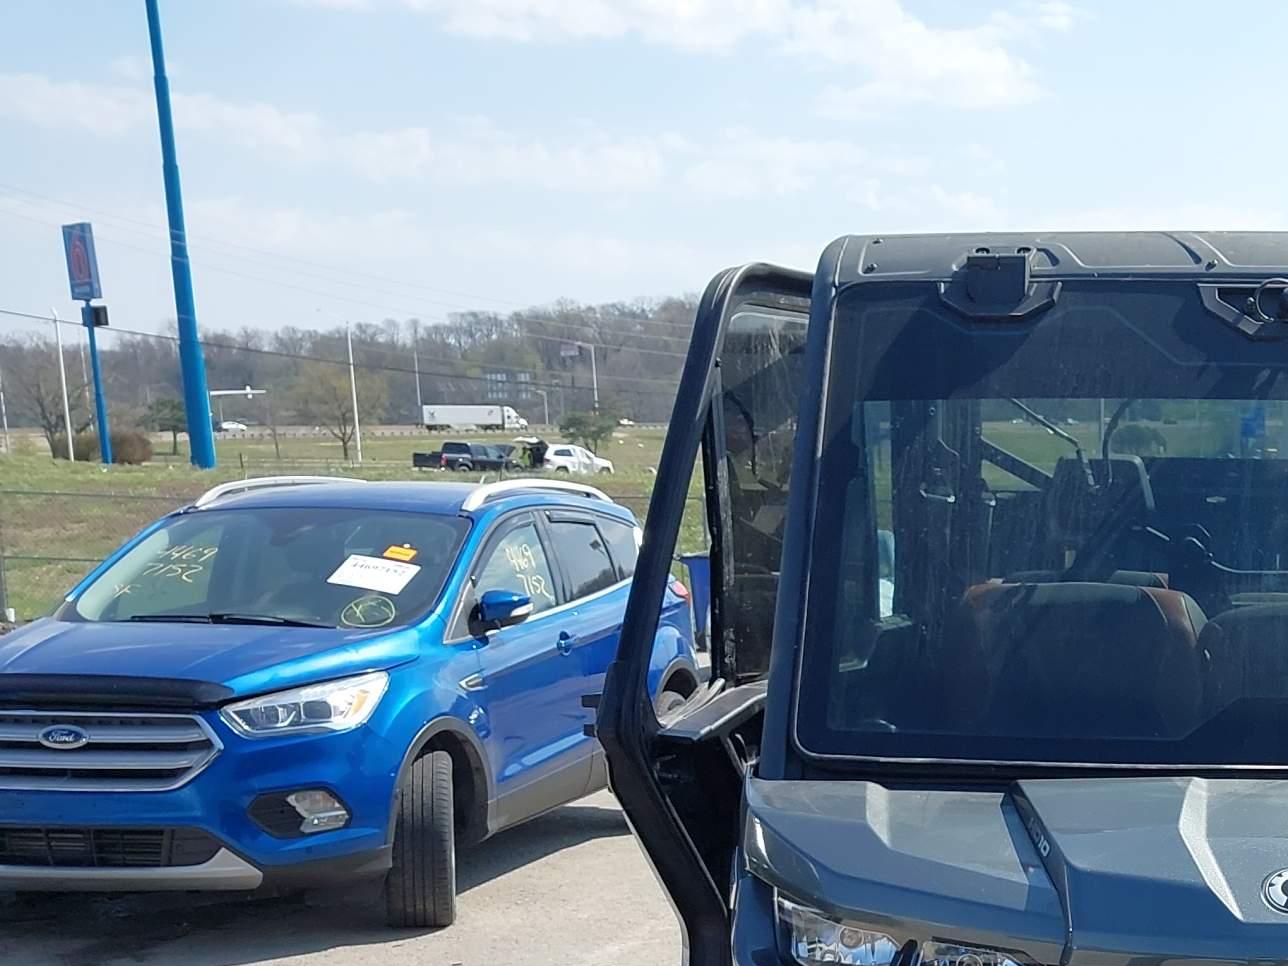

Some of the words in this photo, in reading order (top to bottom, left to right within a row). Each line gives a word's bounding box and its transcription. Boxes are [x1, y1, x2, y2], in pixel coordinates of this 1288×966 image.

[143, 563, 203, 583] 7152
[516, 574, 556, 602] 7152
[48, 731, 75, 742] Ford
